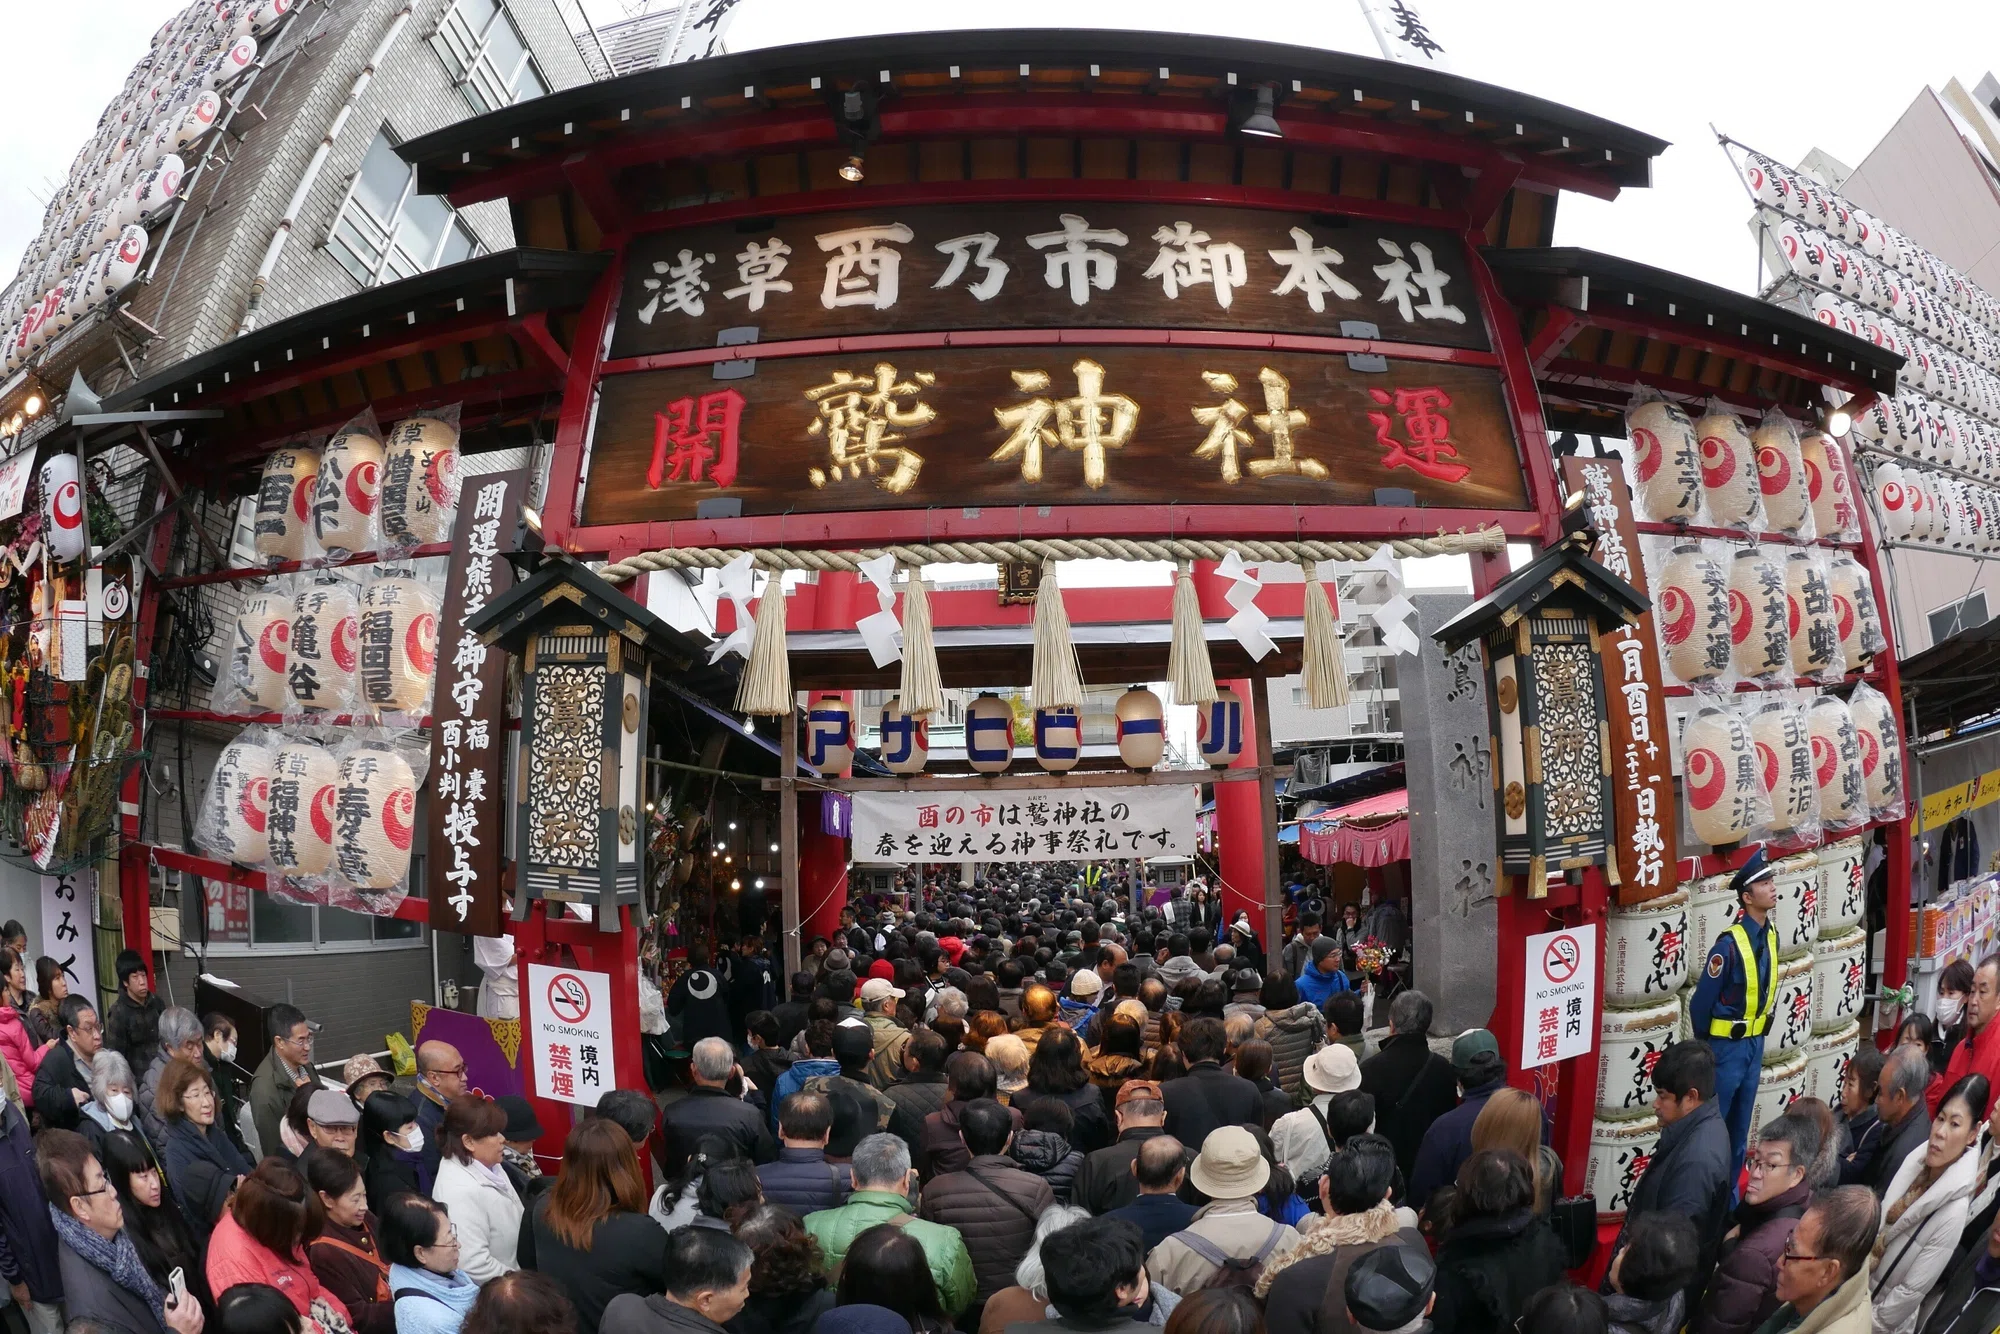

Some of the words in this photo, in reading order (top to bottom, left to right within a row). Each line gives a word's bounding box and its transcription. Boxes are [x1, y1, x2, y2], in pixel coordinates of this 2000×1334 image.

[638, 213, 1467, 324] 浅草酉乃市御本社
[646, 387, 746, 490] 開
[803, 357, 1330, 495] 鷲神社
[1368, 386, 1472, 483] 運
[943, 581, 1000, 591] 台東区立台東病
[917, 801, 1130, 828] 酉の市は鷲神社の
[443, 801, 480, 922] 授与す
[874, 828, 1178, 858] 春を迎える神事祭礼です。
[202, 877, 226, 932] の市
[1536, 990, 1548, 1000] NO
[1550, 982, 1585, 997] SMOKING
[543, 1023, 556, 1033] NO
[558, 1025, 600, 1040] SMOKING
[1537, 1006, 1560, 1061] 禁煙
[1566, 997, 1582, 1039] 境内
[548, 1042, 575, 1098] 禁煙
[579, 1044, 600, 1087] 境内
